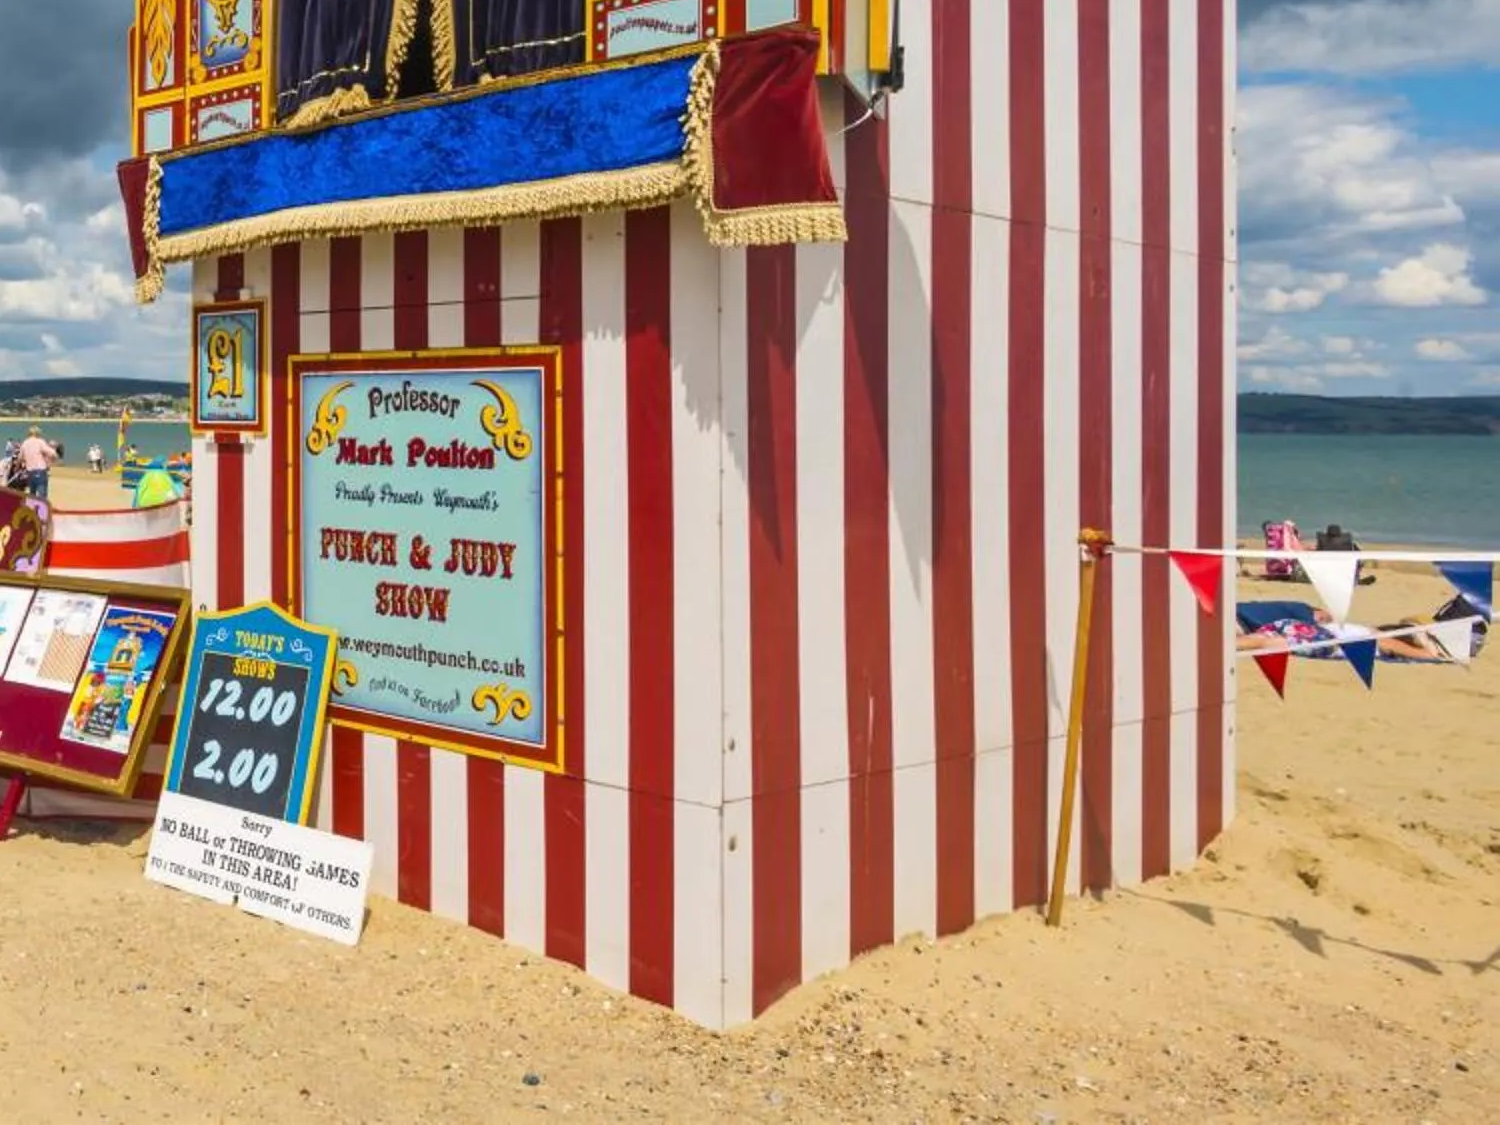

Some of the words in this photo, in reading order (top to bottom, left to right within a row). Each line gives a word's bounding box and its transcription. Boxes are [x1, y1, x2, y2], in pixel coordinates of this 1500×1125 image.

[207, 328, 244, 400] £1
[367, 380, 461, 419] Professor
[335, 437, 394, 467] Mark
[406, 436, 496, 470] Poulton
[380, 481, 424, 506] Presents
[433, 486, 500, 514] Weymouth's
[320, 527, 398, 567] PUNCH
[409, 533, 433, 571] &
[443, 538, 517, 580] JUDY
[375, 581, 451, 624] SHOW
[235, 630, 285, 654] TODAY'S
[233, 657, 277, 681] SHOWS
[200, 677, 297, 727] 12.00
[192, 739, 279, 794] 2.00
[159, 817, 177, 835] NO
[179, 821, 210, 846] BALL
[213, 836, 227, 849] or
[229, 836, 302, 873] THROWING
[241, 816, 274, 839] Sorry
[187, 868, 222, 889] SAFETY
[222, 880, 243, 895] AND
[243, 885, 292, 911] COMFORT
[201, 848, 218, 867] IN
[219, 853, 251, 879] THIS
[252, 866, 299, 892] AREA!
